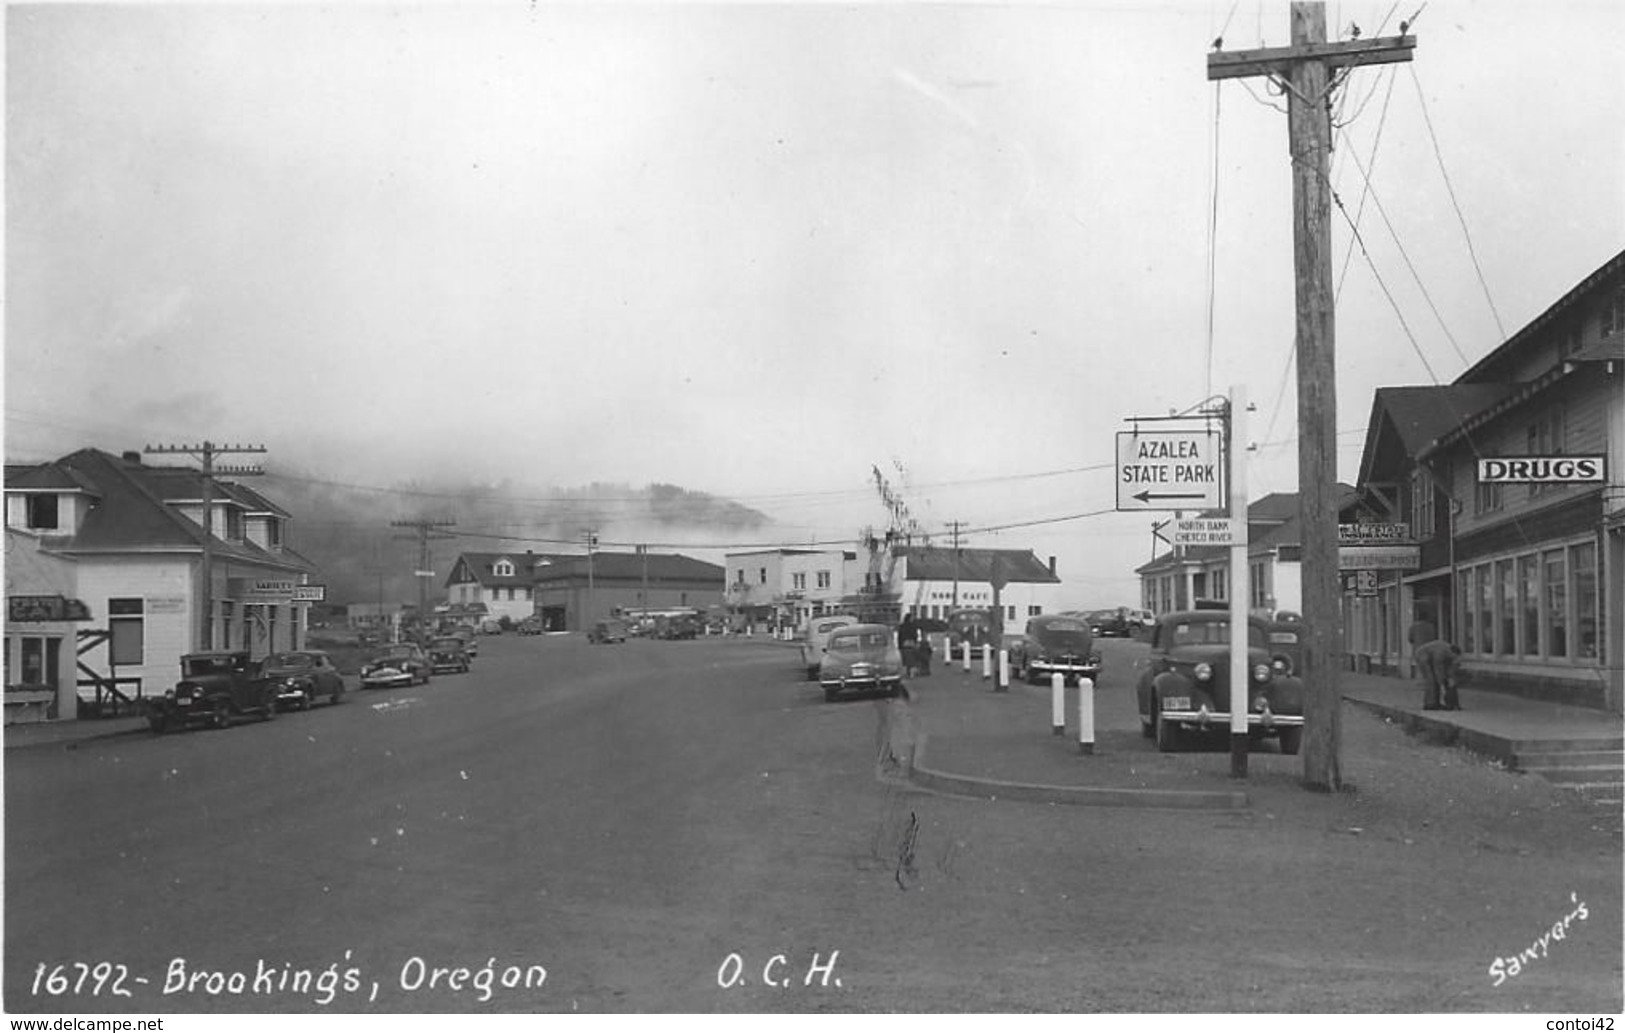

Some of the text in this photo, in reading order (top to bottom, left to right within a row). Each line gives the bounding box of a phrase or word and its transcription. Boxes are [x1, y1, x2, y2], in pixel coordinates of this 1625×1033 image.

[1138, 440, 1199, 459] AZALEA
[1122, 465, 1215, 483] STATE PARK
[1485, 460, 1598, 479] DRUGS
[1178, 521, 1230, 531] NORTH BANK
[1175, 532, 1233, 543] CHETCO RIVER
[962, 592, 989, 600] CAFE
